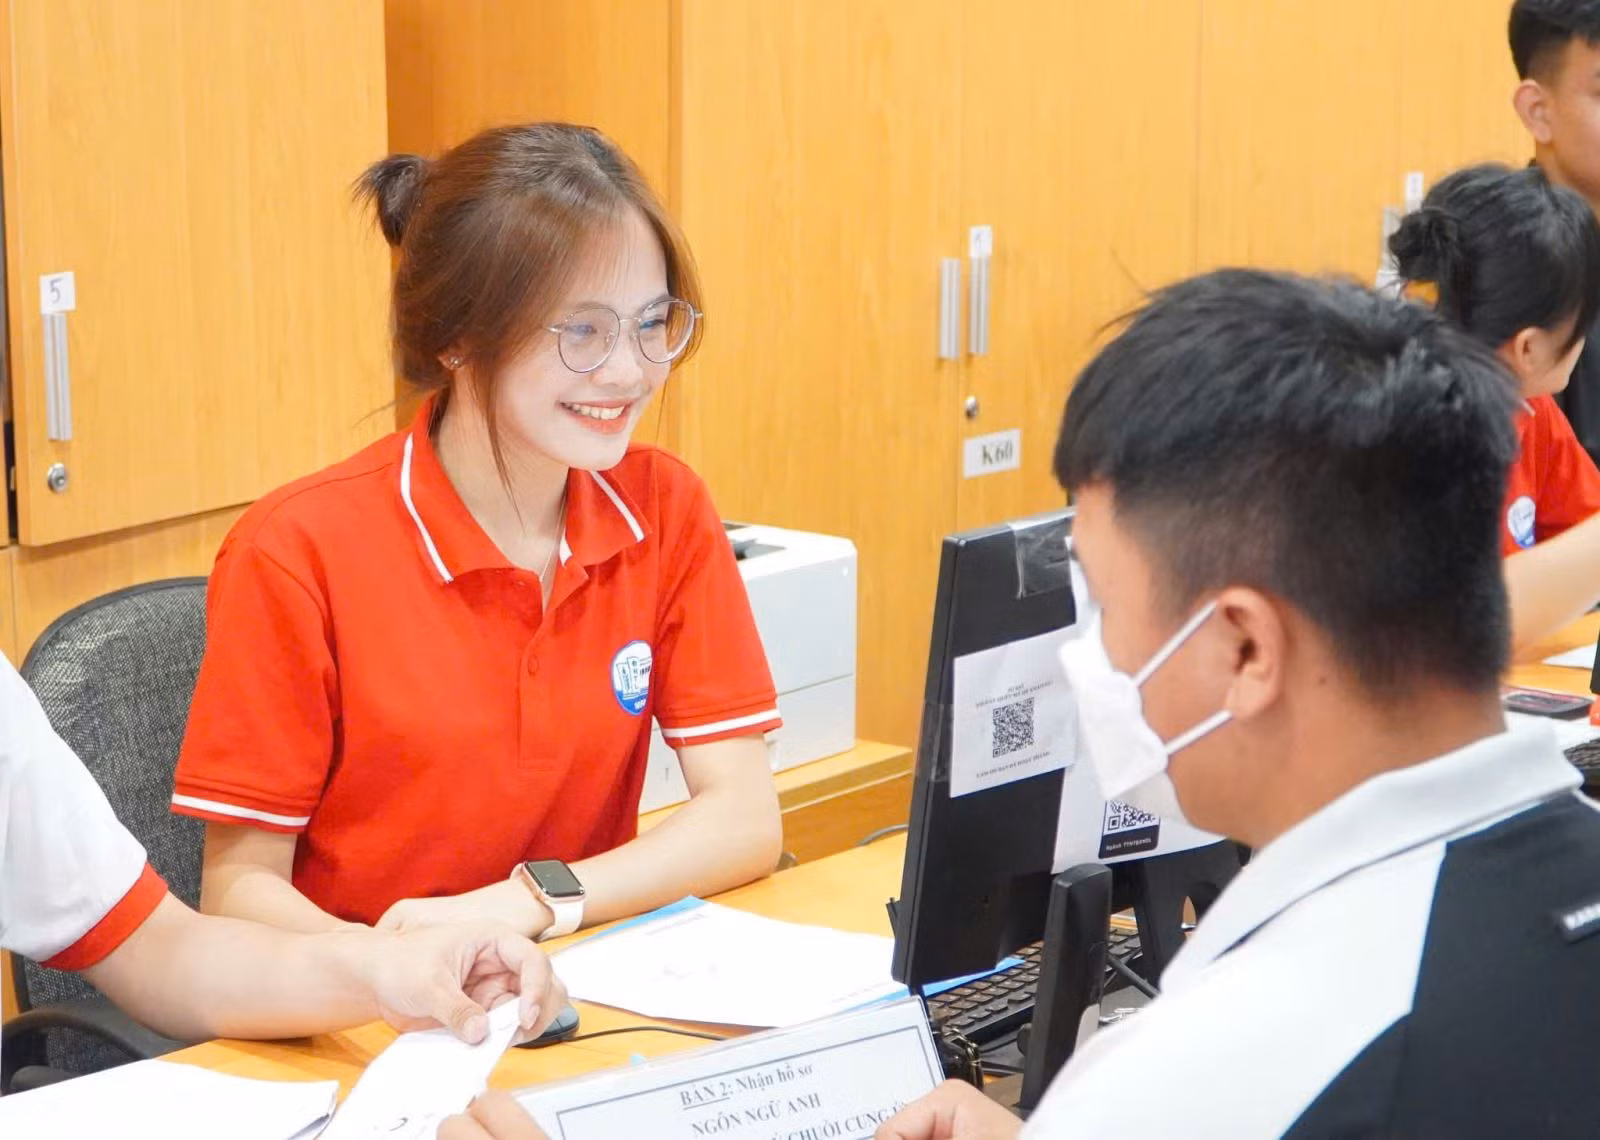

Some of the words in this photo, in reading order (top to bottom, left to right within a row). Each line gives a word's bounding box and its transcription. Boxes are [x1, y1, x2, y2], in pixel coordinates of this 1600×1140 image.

[50, 278, 63, 304] 5
[735, 1073, 774, 1092] Nhận
[778, 1063, 795, 1083] hồ
[798, 1063, 813, 1078] sơ
[691, 1112, 743, 1138] NGÔN
[788, 1092, 822, 1115] ANH
